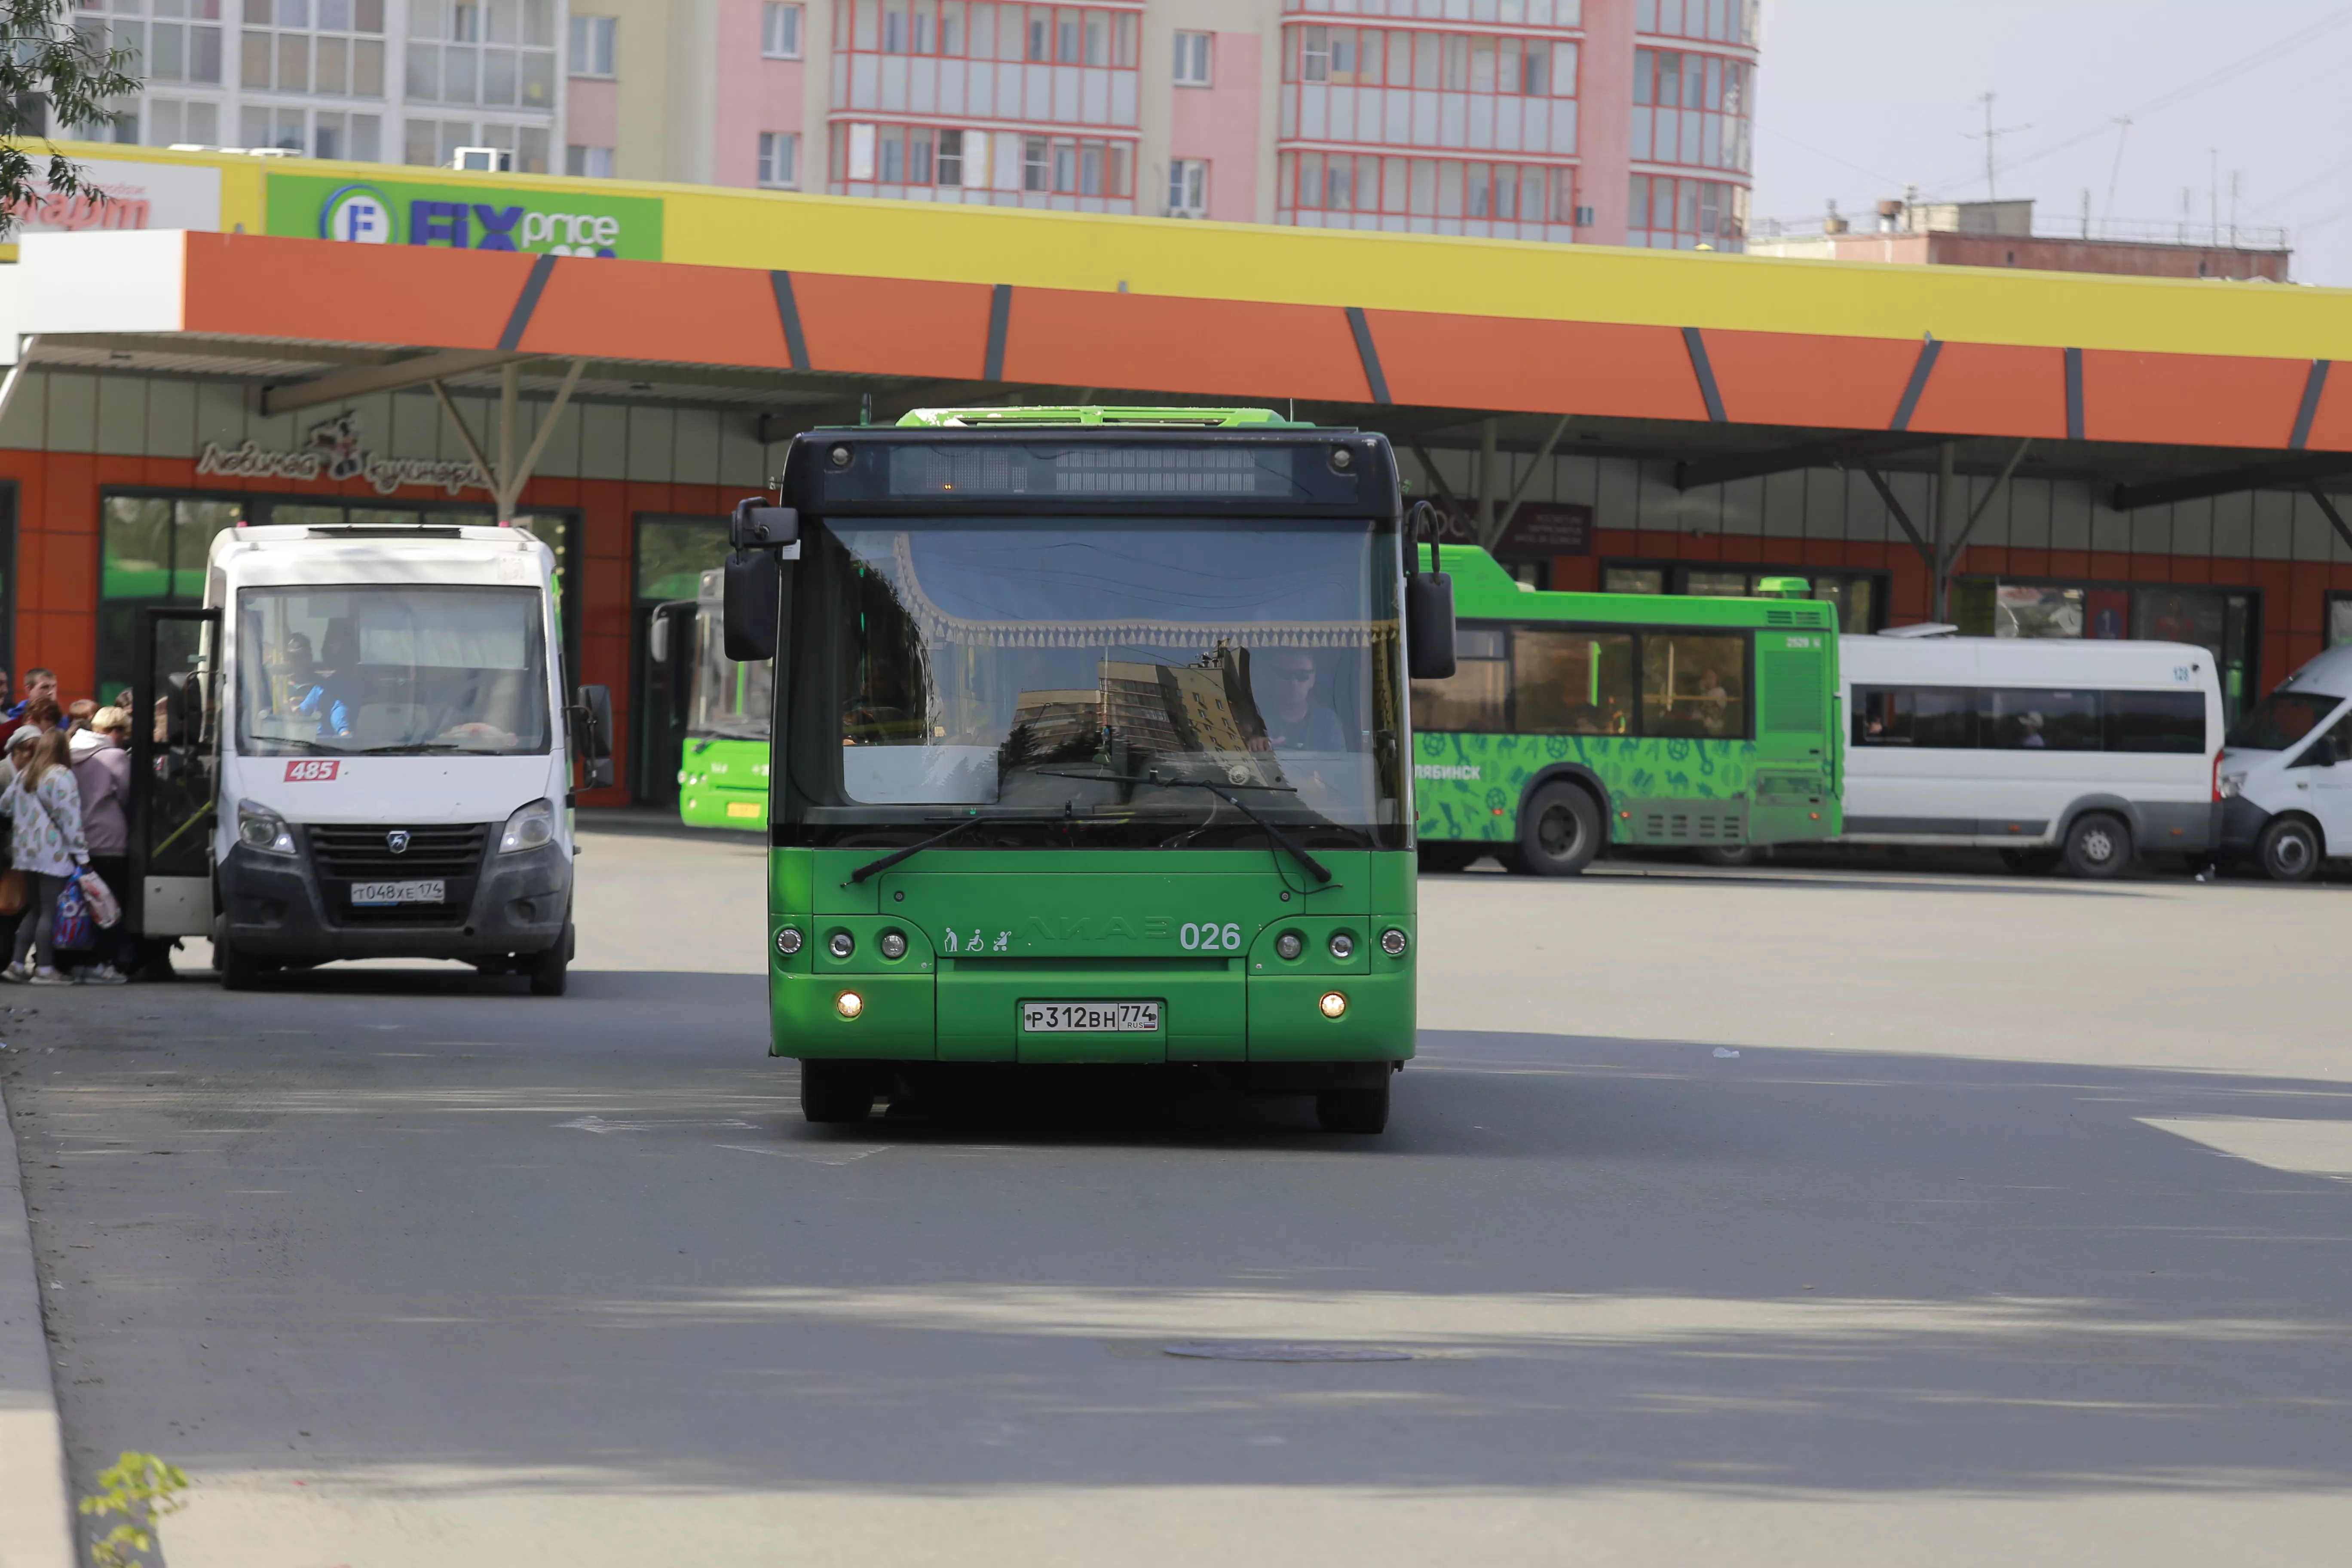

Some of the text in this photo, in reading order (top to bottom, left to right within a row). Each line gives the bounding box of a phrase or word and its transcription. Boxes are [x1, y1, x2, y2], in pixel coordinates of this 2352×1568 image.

[521, 211, 620, 249] price
[289, 761, 335, 780] 485
[1180, 923, 1241, 950] 026
[1032, 1005, 1154, 1028] Р312ВН 774
